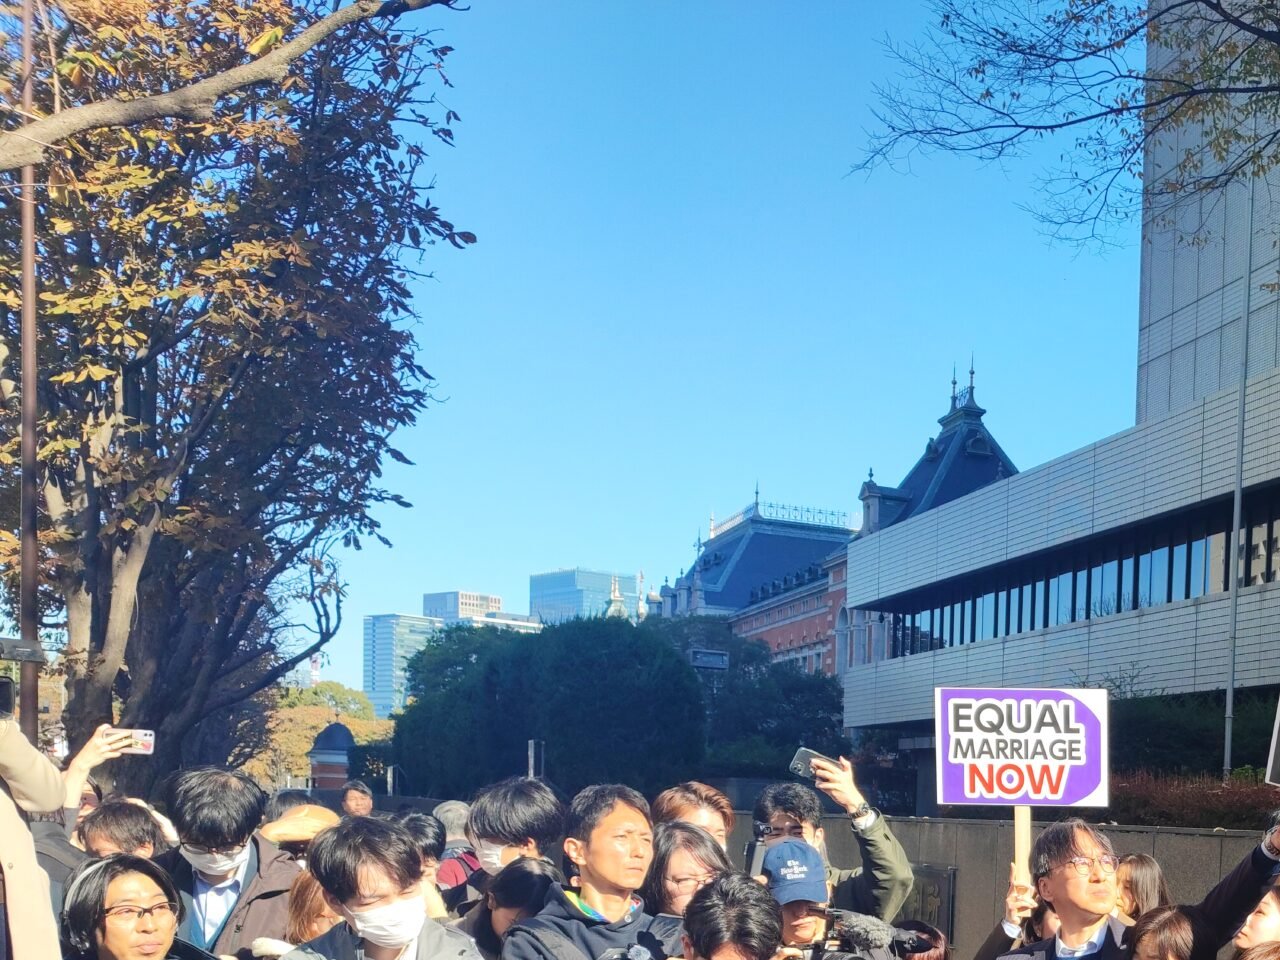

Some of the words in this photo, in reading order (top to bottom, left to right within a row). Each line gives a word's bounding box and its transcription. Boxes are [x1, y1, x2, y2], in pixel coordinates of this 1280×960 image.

[953, 703, 1080, 736] EQUAL
[953, 738, 1082, 761] MARRIAGE
[969, 763, 1065, 795] NOW
